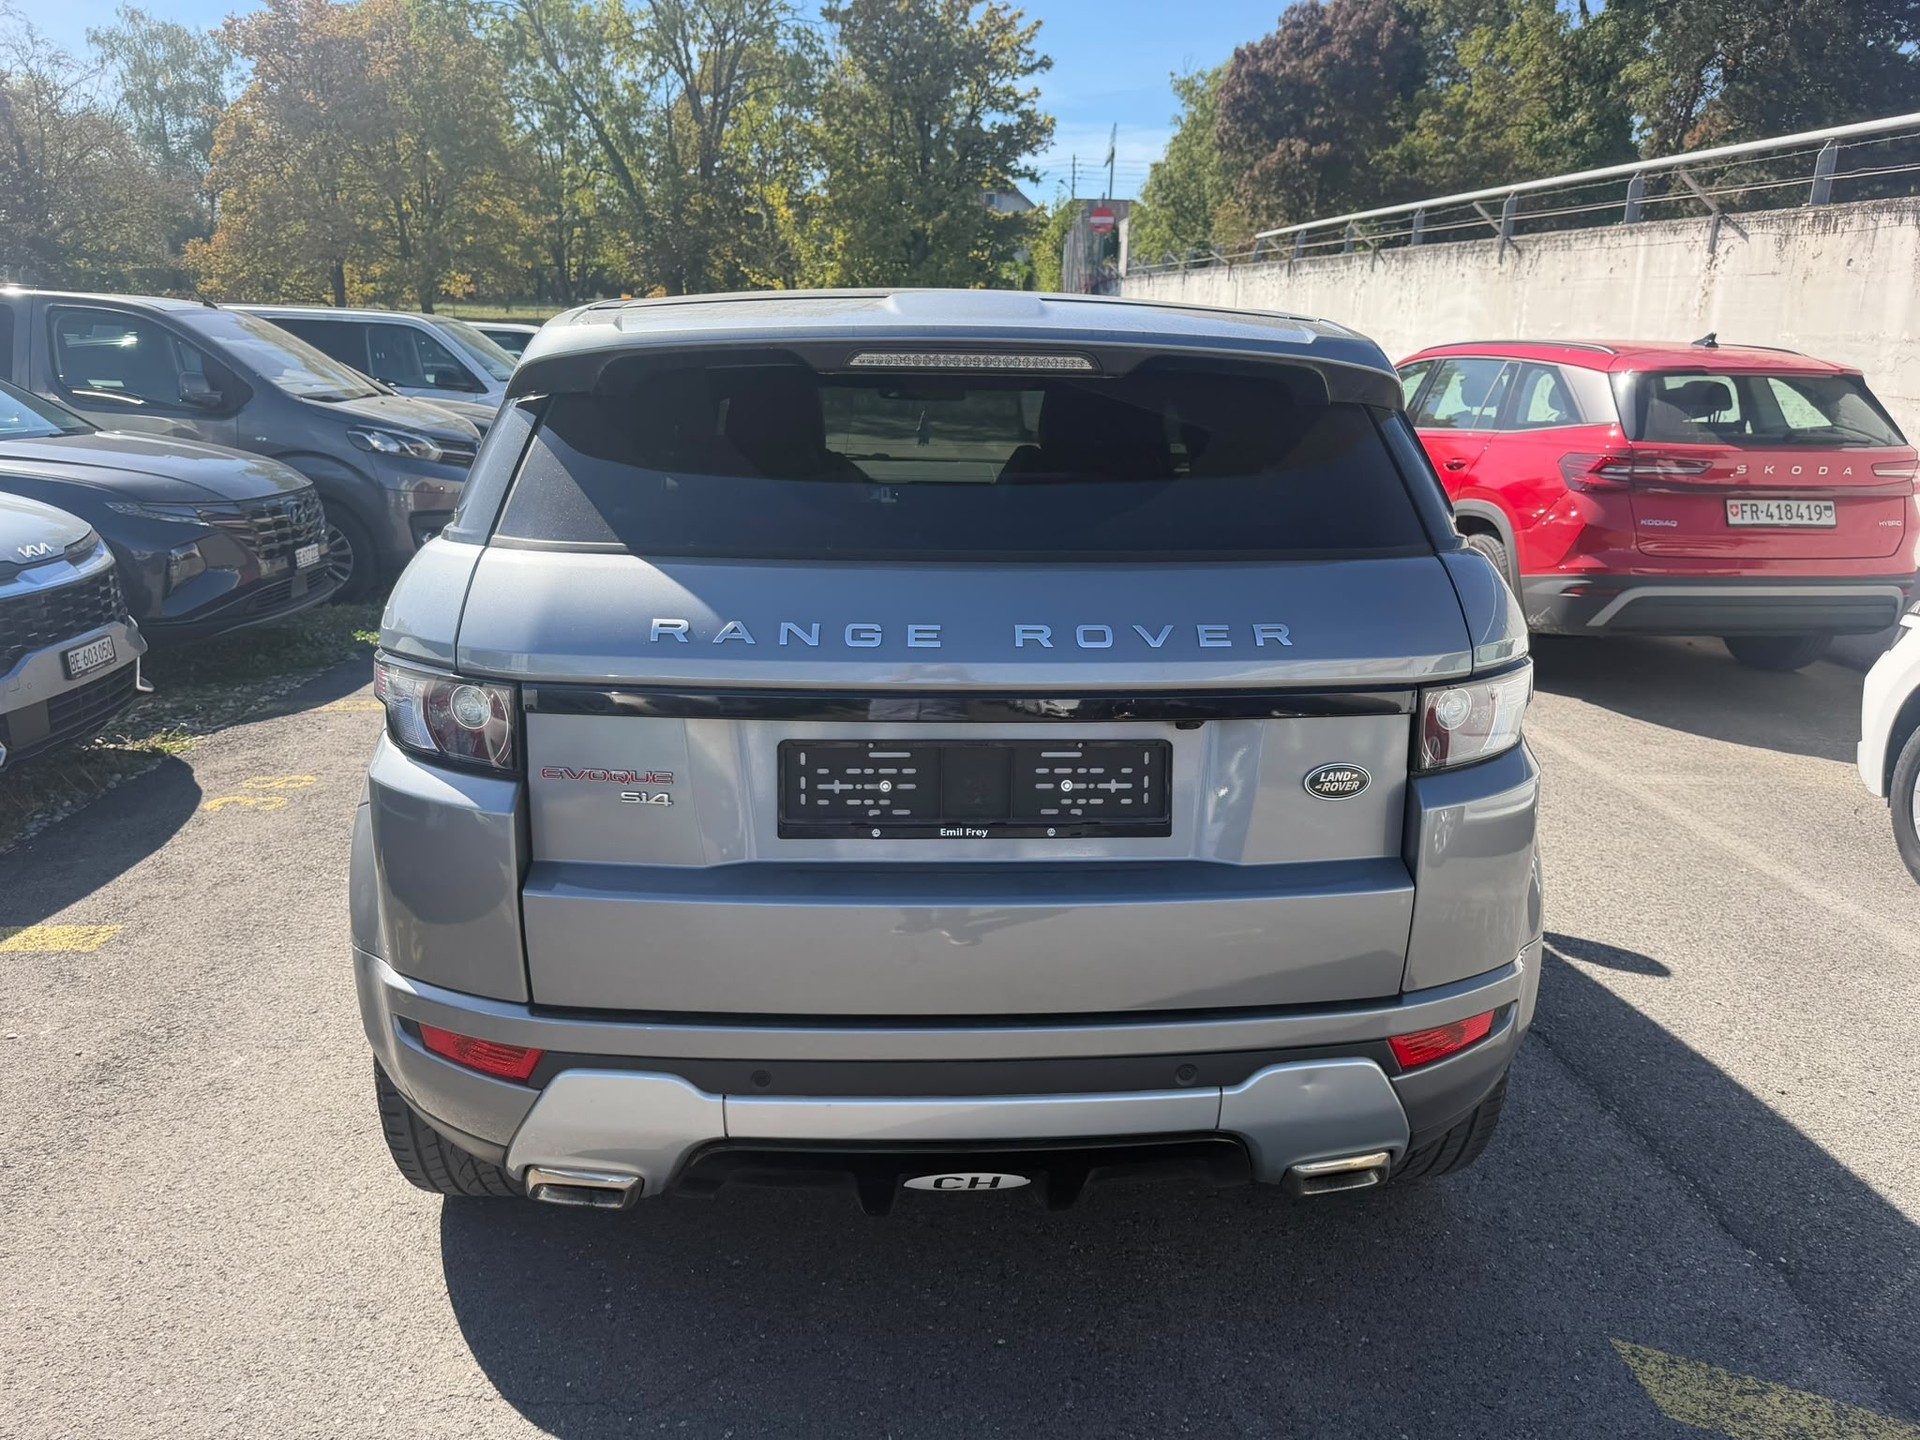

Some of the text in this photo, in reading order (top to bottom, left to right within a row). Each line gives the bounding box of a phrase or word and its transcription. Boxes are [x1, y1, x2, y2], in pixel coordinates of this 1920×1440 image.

[1736, 465, 1852, 476] SKODA
[1640, 519, 1678, 528] KODIAQ
[650, 618, 1293, 648] RANGE ROVER
[541, 767, 674, 785] EVOQUE
[1319, 771, 1352, 782] LAND
[1321, 780, 1360, 792] ROVER
[620, 791, 673, 807] Si4
[940, 828, 989, 838] Emil Frey
[933, 1176, 1002, 1190] CH
